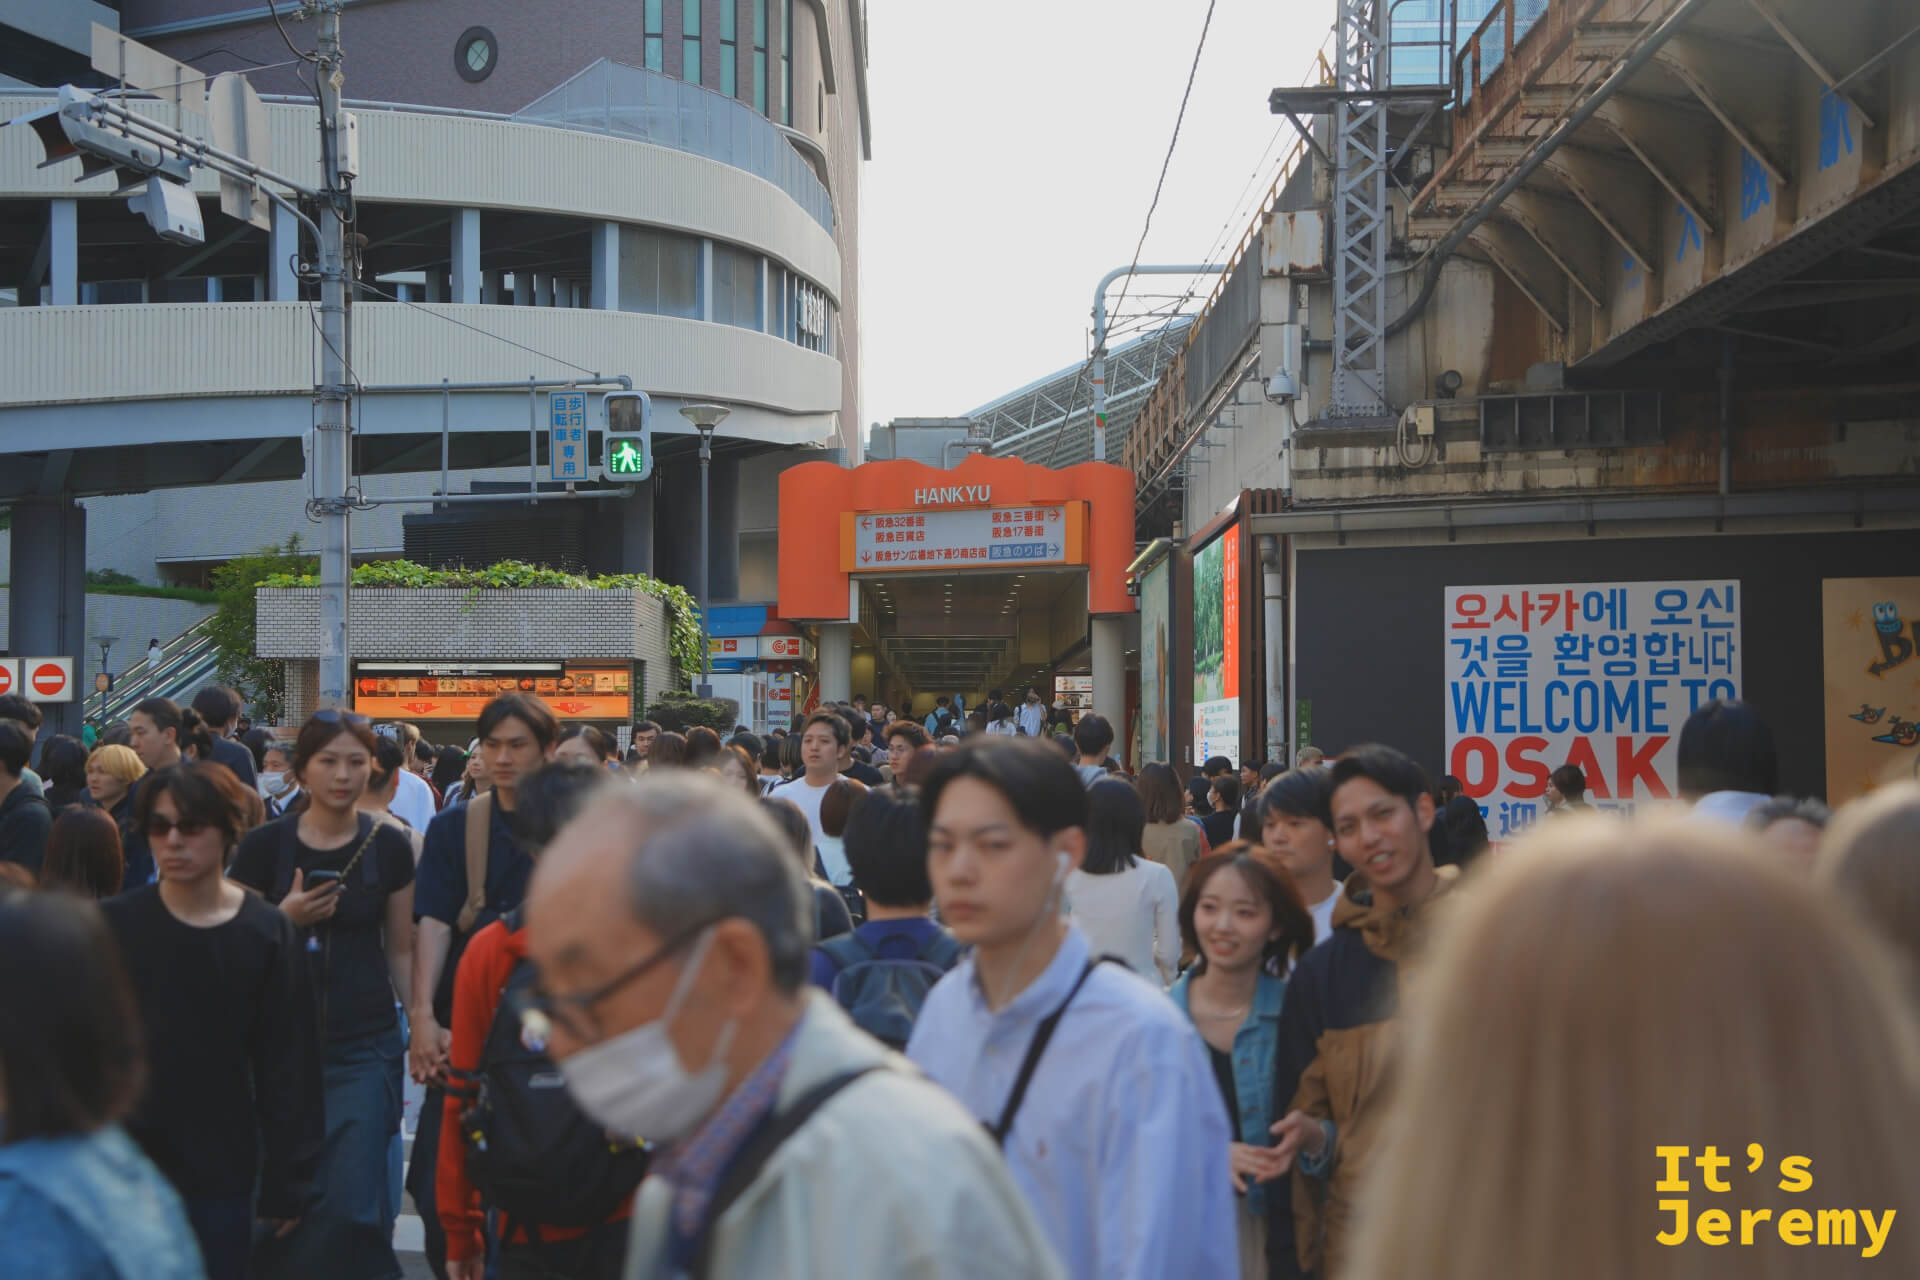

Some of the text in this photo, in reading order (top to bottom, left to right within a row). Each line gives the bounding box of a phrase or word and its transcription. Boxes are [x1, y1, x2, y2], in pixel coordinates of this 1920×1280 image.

[555, 397, 567, 442] 自転車
[569, 397, 582, 442] 歩行者
[563, 445, 576, 475] 専用
[914, 484, 992, 505] HANKYU
[875, 531, 926, 544] 阪急百貨店
[1451, 585, 1735, 632] 오사카에 오신
[1450, 631, 1735, 678] 것을 환영합니다
[1450, 679, 1669, 734] WELCOME
[1451, 735, 1683, 800] OSAK
